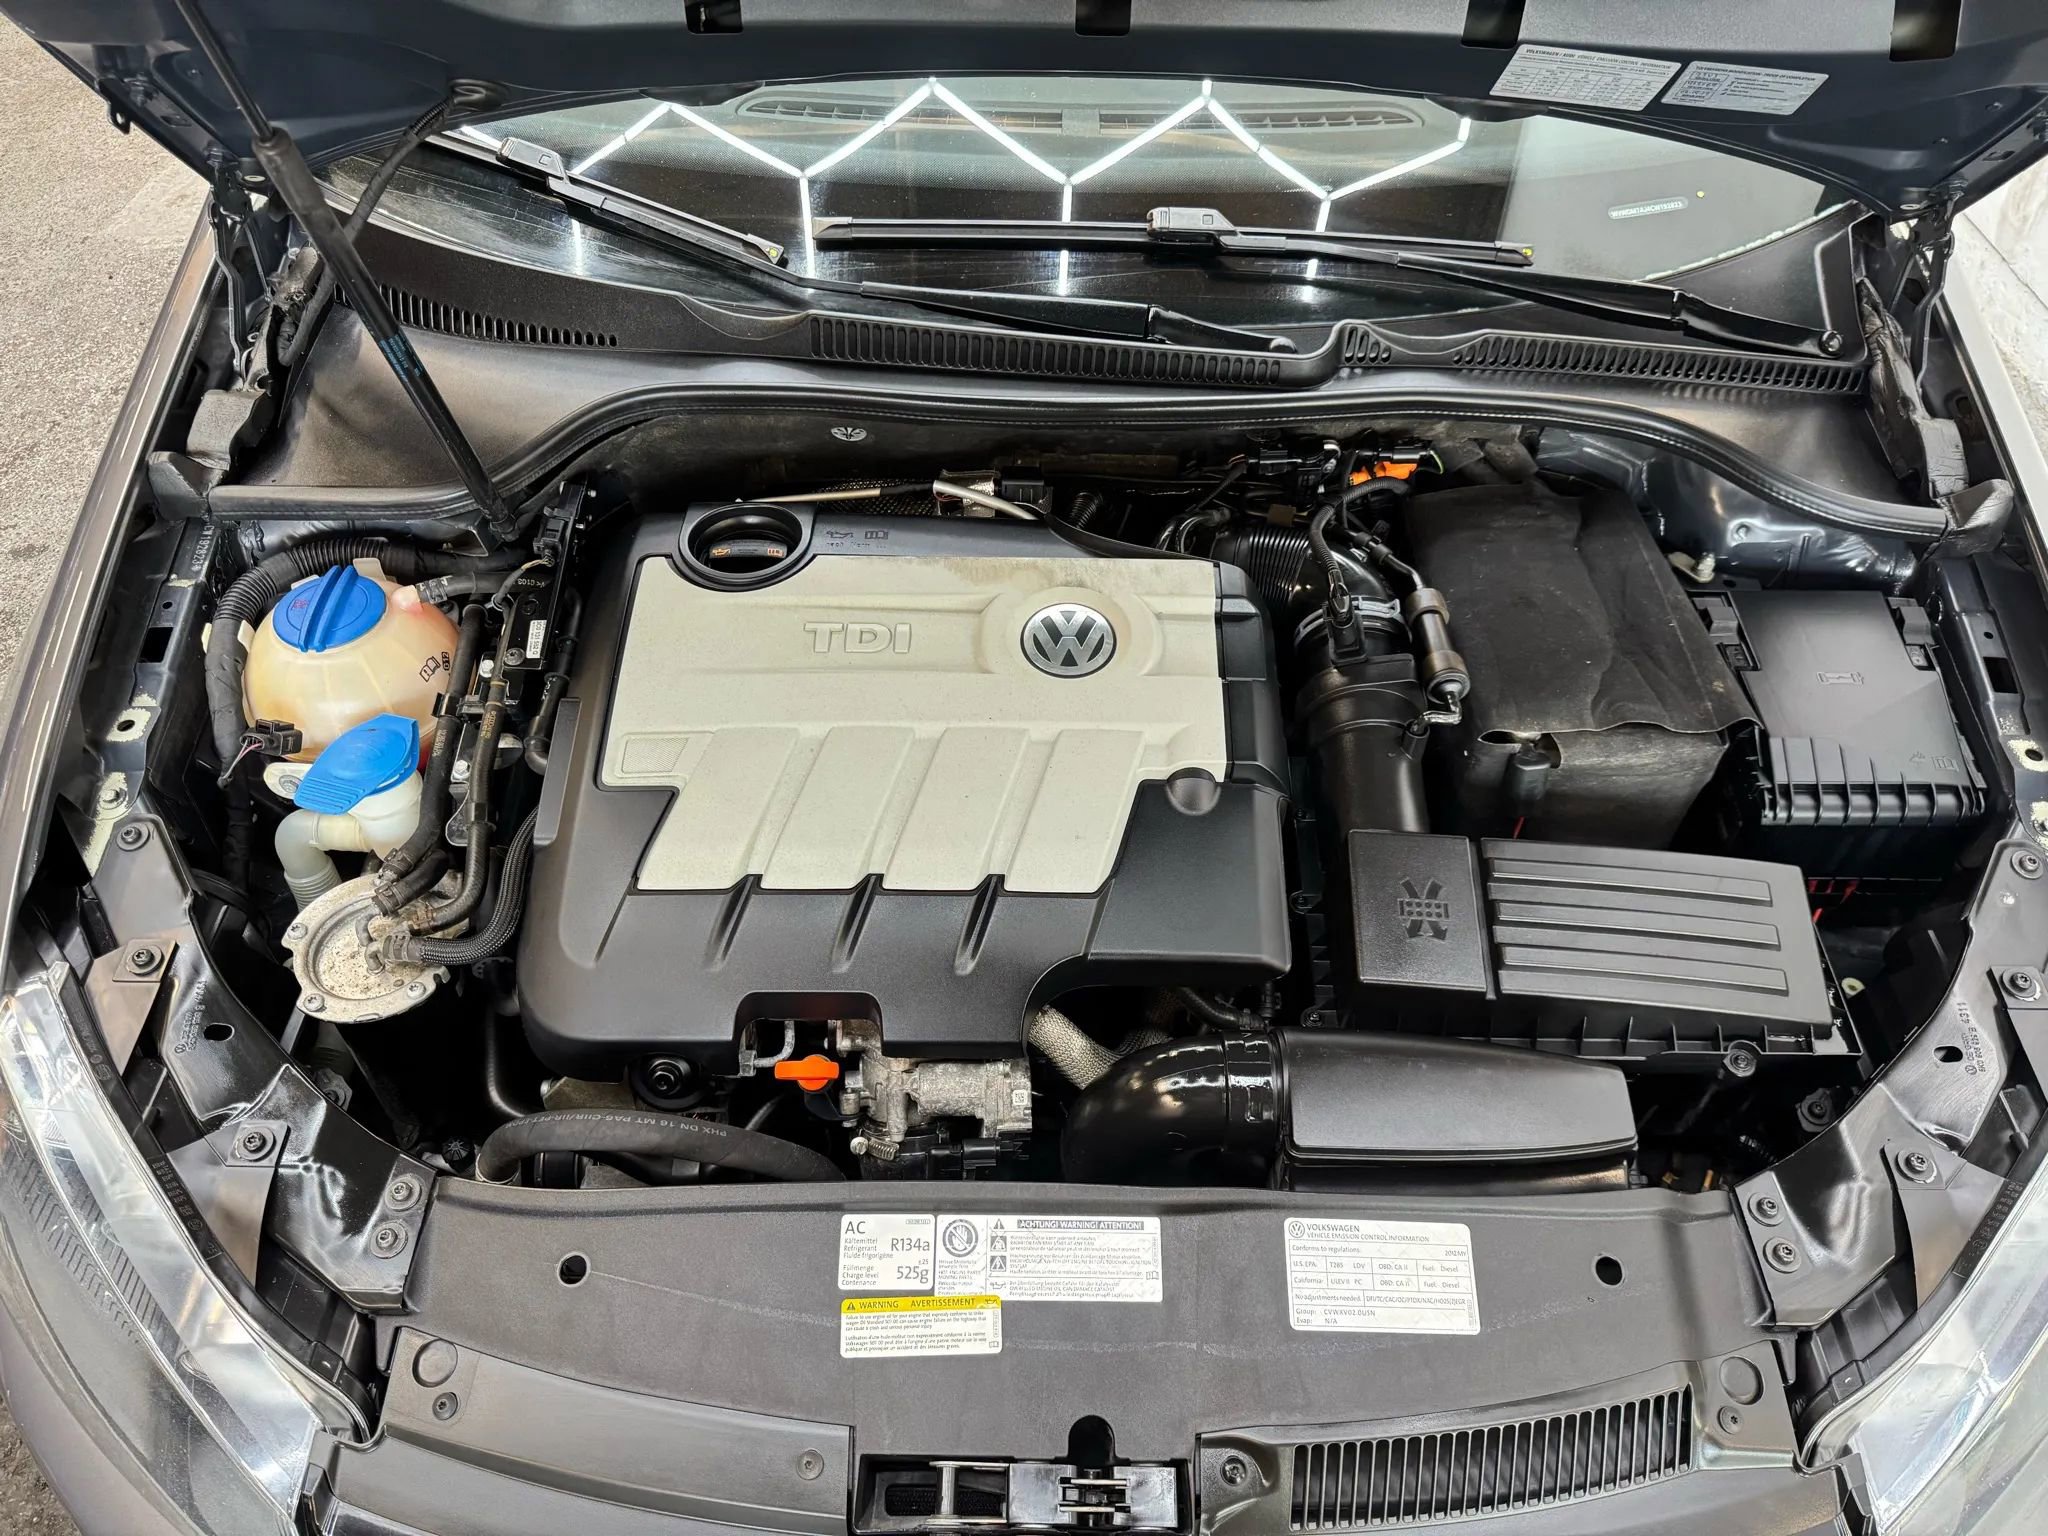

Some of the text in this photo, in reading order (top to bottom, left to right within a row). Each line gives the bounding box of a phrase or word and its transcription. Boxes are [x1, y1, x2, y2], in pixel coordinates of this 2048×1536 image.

[803, 622, 912, 654] TDI
[1026, 606, 1111, 673] VW
[844, 1220, 866, 1234] AC
[1020, 1220, 1142, 1230] ACHTUNG! WARNING! ATTENTION!
[1306, 1223, 1360, 1232] VOLKSWAGEN
[1360, 1233, 1387, 1241] CONTROL
[1388, 1234, 1430, 1242] INFORMATION
[891, 1237, 930, 1252] R134a
[1440, 1264, 1459, 1272] Diesel
[842, 1272, 864, 1280] Charge
[896, 1265, 929, 1284] 525g
[1441, 1281, 1460, 1289] Diesel
[859, 1298, 975, 1309] WARNING AVERTISSEMENT
